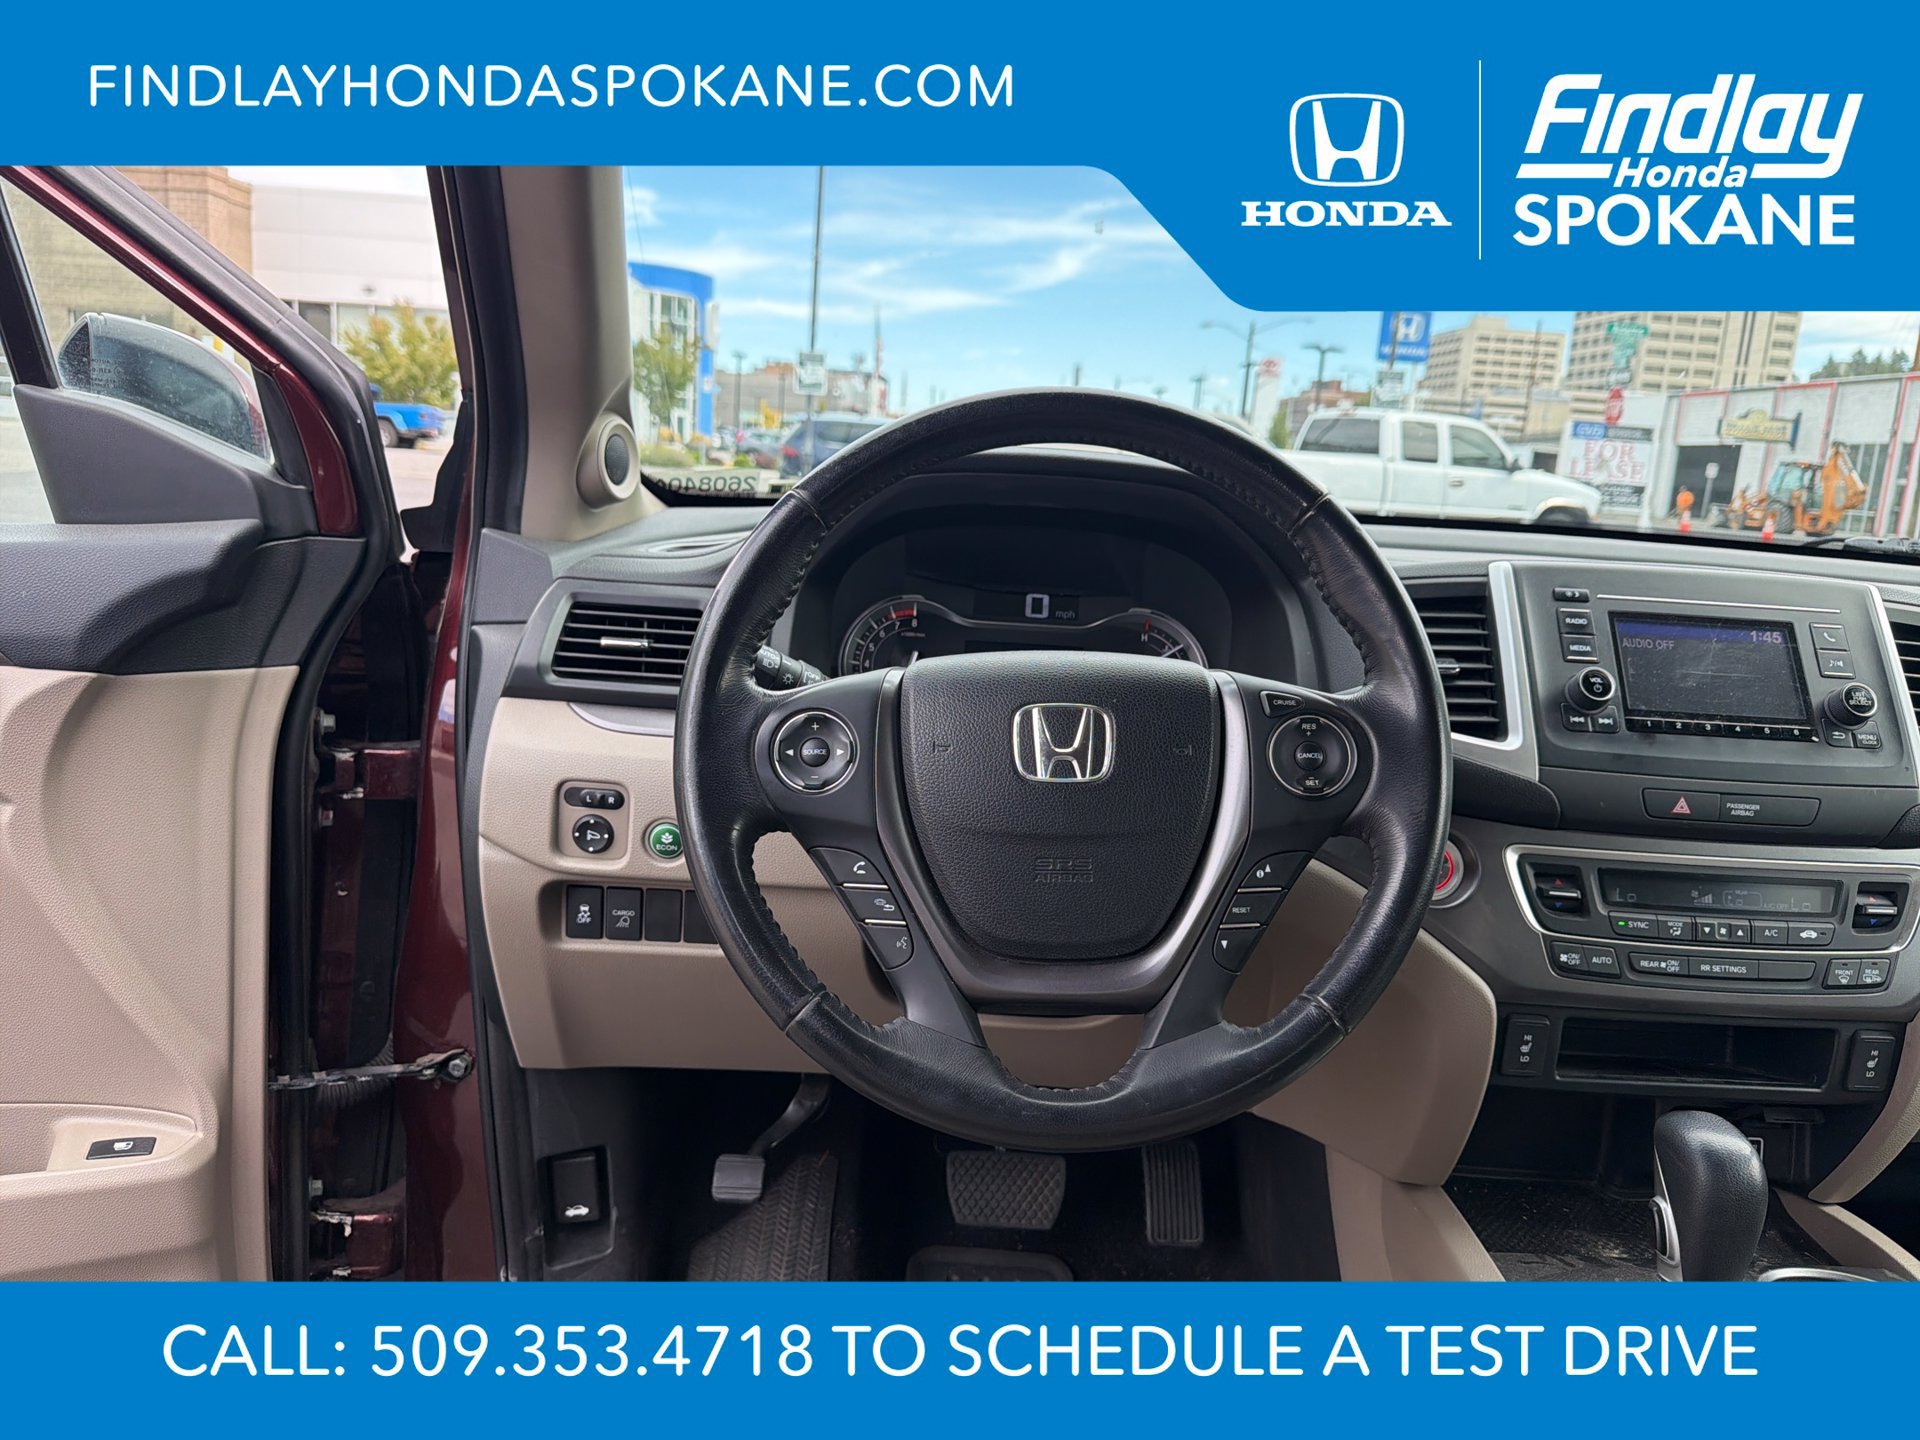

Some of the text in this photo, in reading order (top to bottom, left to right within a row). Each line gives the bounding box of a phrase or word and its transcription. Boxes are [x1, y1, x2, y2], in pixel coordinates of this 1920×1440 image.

[1055, 609, 1076, 620] mph
[1565, 617, 1588, 625] RADIO
[1750, 630, 1783, 644] 1:45
[1569, 644, 1592, 652] MEDIA
[1622, 638, 1675, 650] AUDIO OFF
[1273, 698, 1297, 706] CRUISE
[1301, 723, 1317, 731] RES
[803, 748, 827, 756] SOURCE
[1305, 779, 1320, 787] SET
[1726, 802, 1760, 811] PASSENGER
[1730, 808, 1755, 817] AIRBAG
[656, 843, 678, 851] ECON
[612, 909, 635, 917] CARGO
[1231, 906, 1251, 914] RESET
[576, 916, 592, 924] OFF
[1627, 920, 1650, 929] SYNC
[1764, 928, 1779, 938] A/C
[1591, 956, 1613, 965] AUTO
[1640, 959, 1660, 968] REAR
[1700, 964, 1747, 974] RR SETTINGS
[1520, 1055, 1530, 1063] LO
[1865, 1070, 1875, 1078] LO
